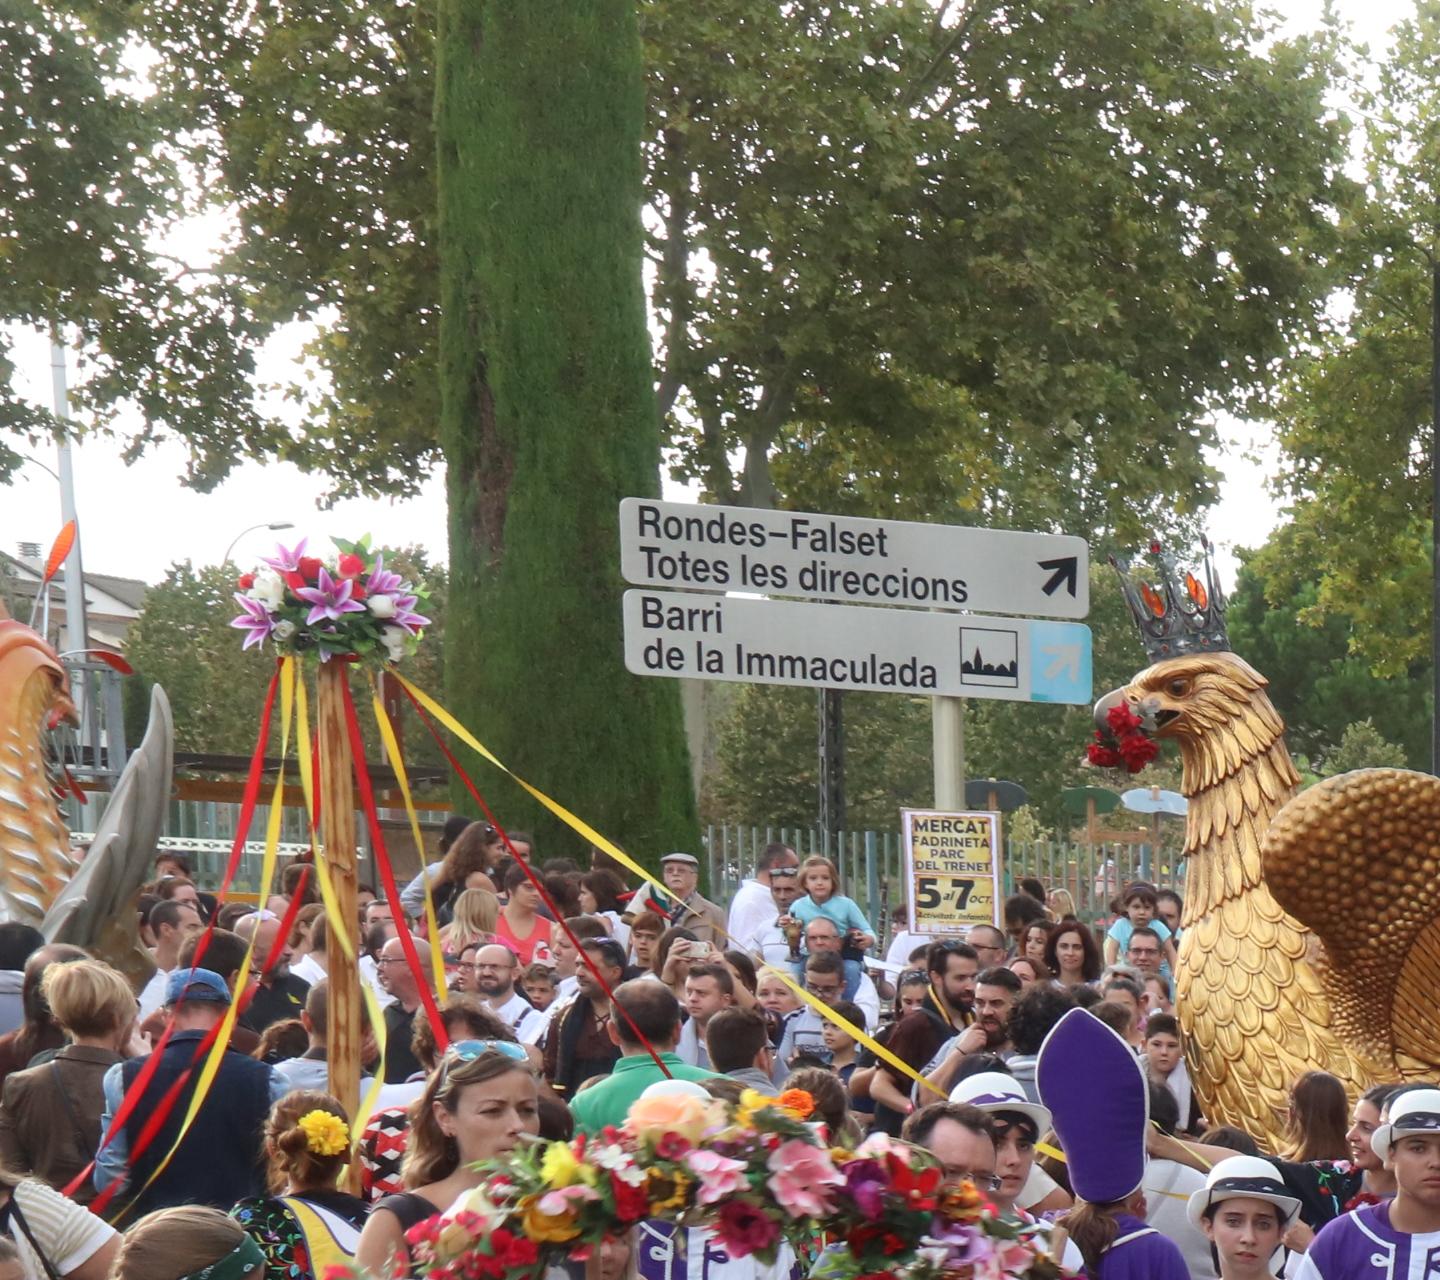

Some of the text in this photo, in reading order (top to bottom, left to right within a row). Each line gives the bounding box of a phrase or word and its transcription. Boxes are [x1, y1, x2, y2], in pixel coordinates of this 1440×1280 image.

[639, 546, 969, 603] Totes les direccions
[641, 596, 723, 633] Barri
[643, 638, 938, 689] de la Immaculada
[914, 819, 988, 834] MERCAT
[911, 836, 990, 849] FADRINETA
[930, 849, 965, 859] PARC
[915, 860, 991, 872] DEL TRENET
[917, 877, 942, 910] 5
[943, 890, 956, 901] al
[951, 878, 975, 911] 7
